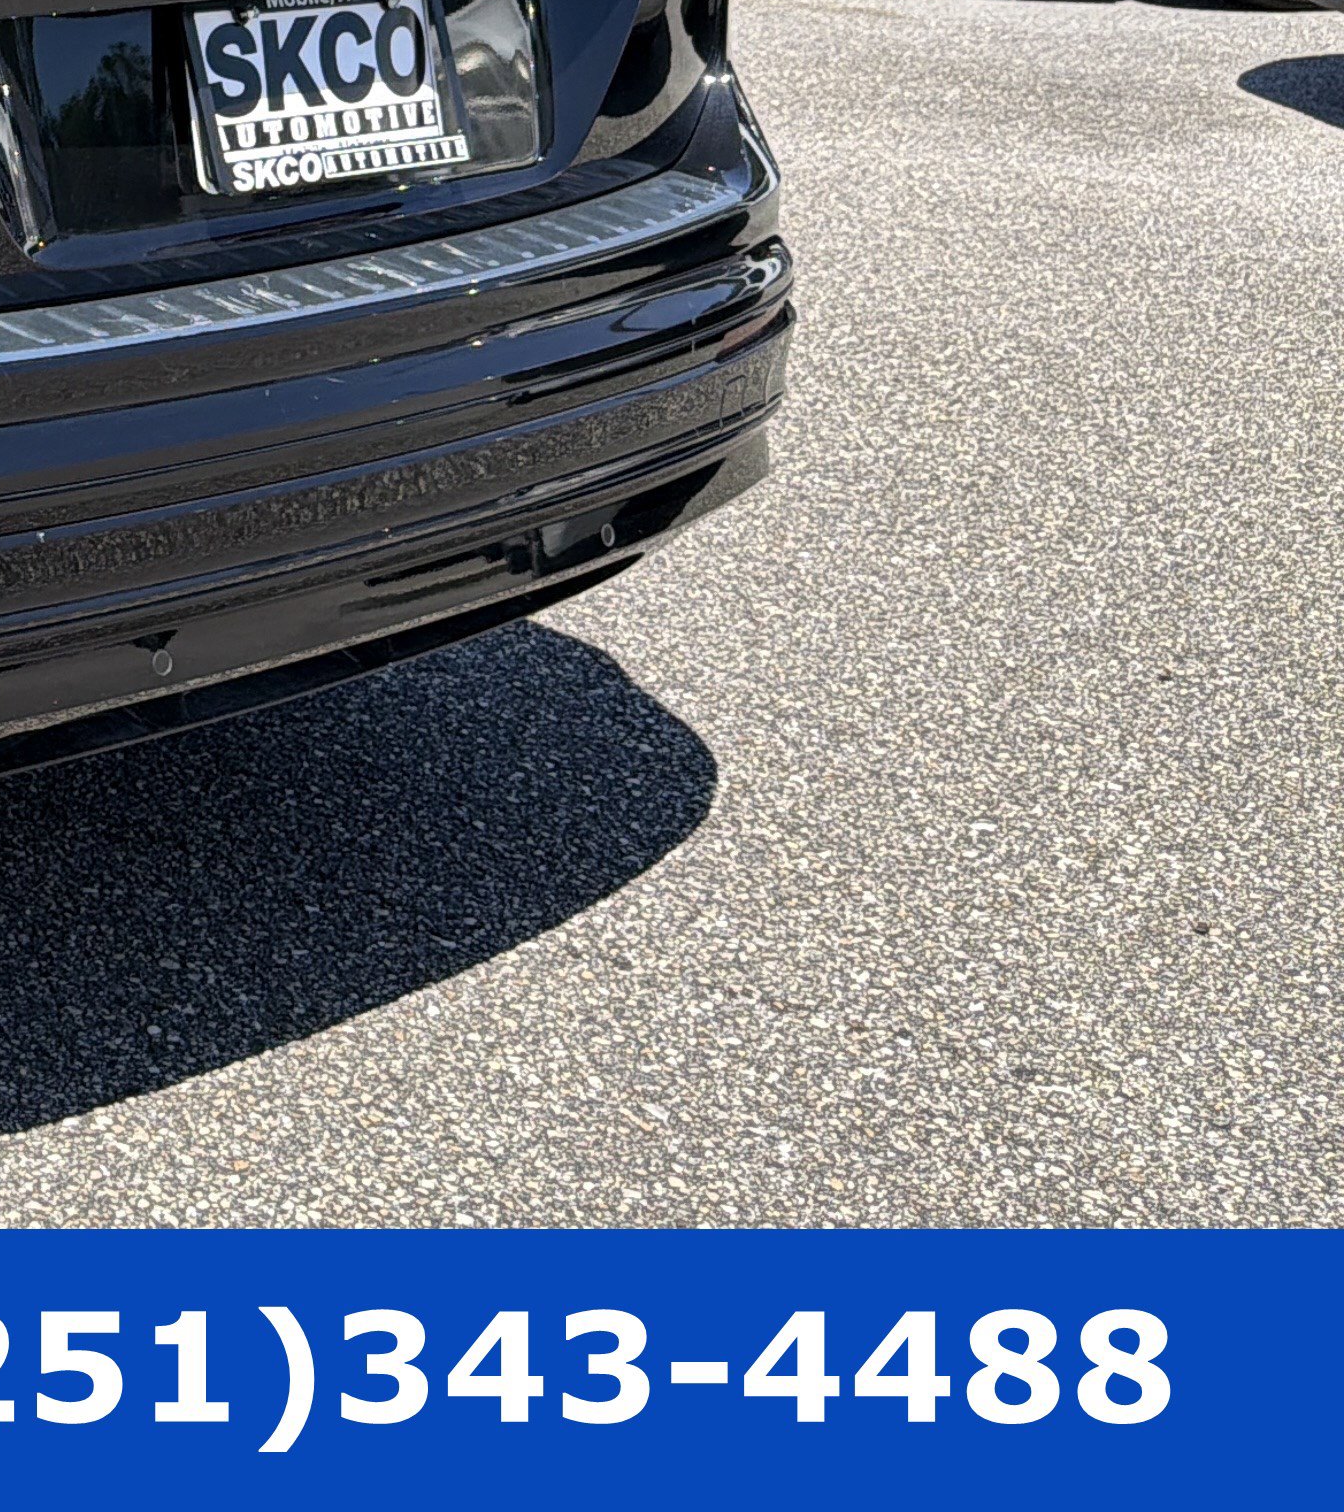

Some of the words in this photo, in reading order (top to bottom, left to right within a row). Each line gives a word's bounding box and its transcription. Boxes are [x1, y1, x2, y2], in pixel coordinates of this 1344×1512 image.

[205, 6, 426, 117] SKCO
[232, 153, 324, 192] SKCO
[327, 139, 467, 174] AUTOMOTIVE
